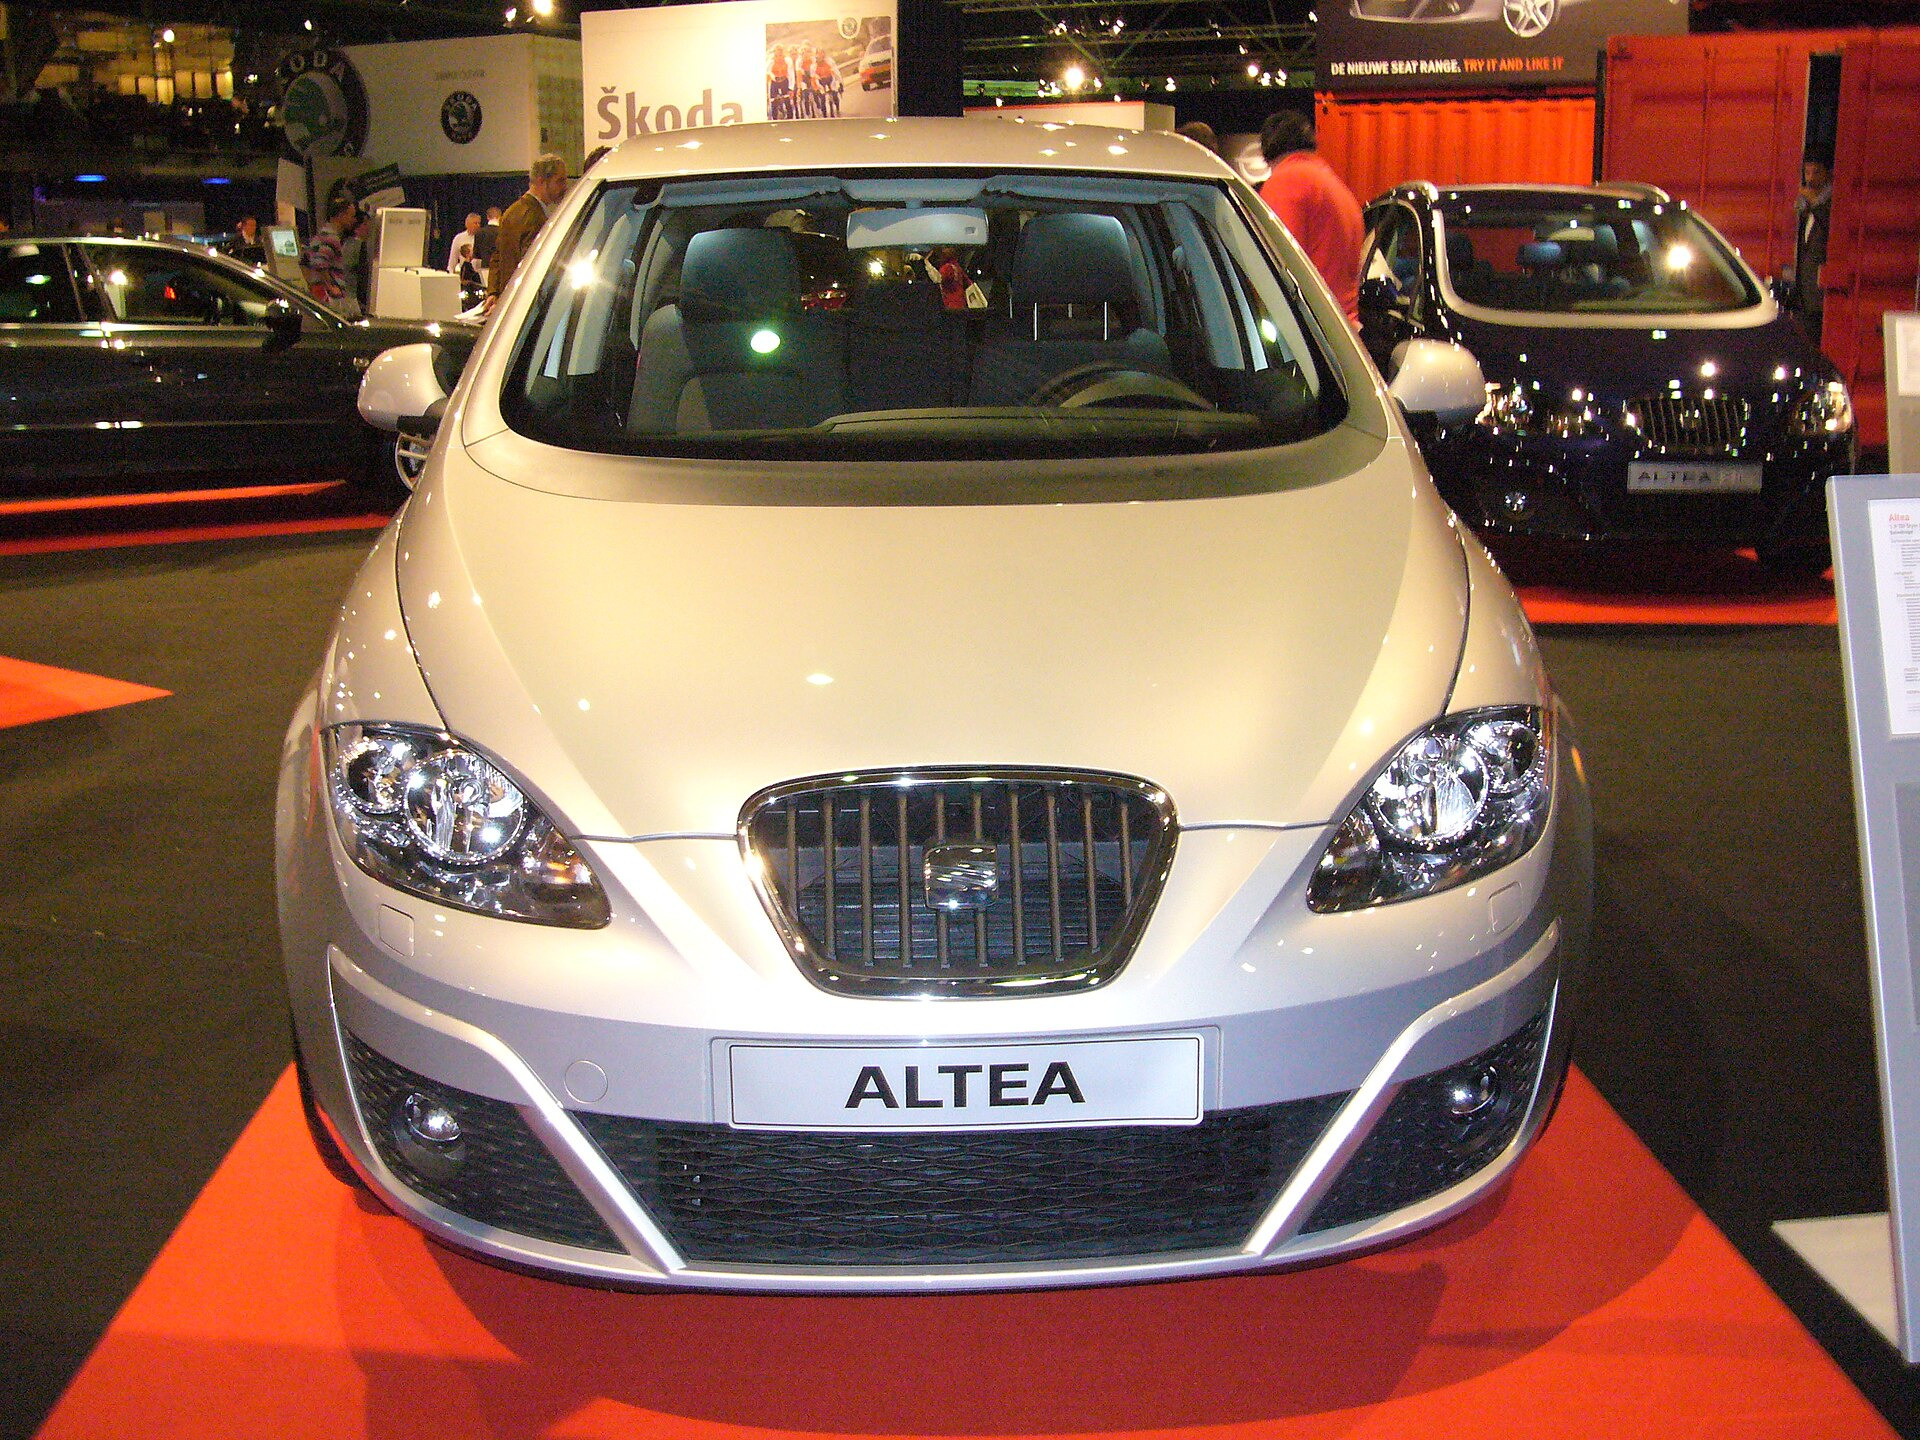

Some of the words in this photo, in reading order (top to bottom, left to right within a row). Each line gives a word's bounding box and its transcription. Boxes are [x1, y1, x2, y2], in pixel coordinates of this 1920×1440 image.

[1330, 61, 1346, 76] DE
[1347, 60, 1389, 75] NIEUWE
[1391, 59, 1418, 74] SEAT
[1419, 58, 1462, 74] RANGE.
[1463, 57, 1485, 72] TRY
[1486, 57, 1498, 71] IT
[1499, 56, 1524, 71] AND
[1525, 56, 1551, 71] LIKE
[1552, 56, 1565, 71] IT
[844, 1061, 1086, 1109] ALTEA
